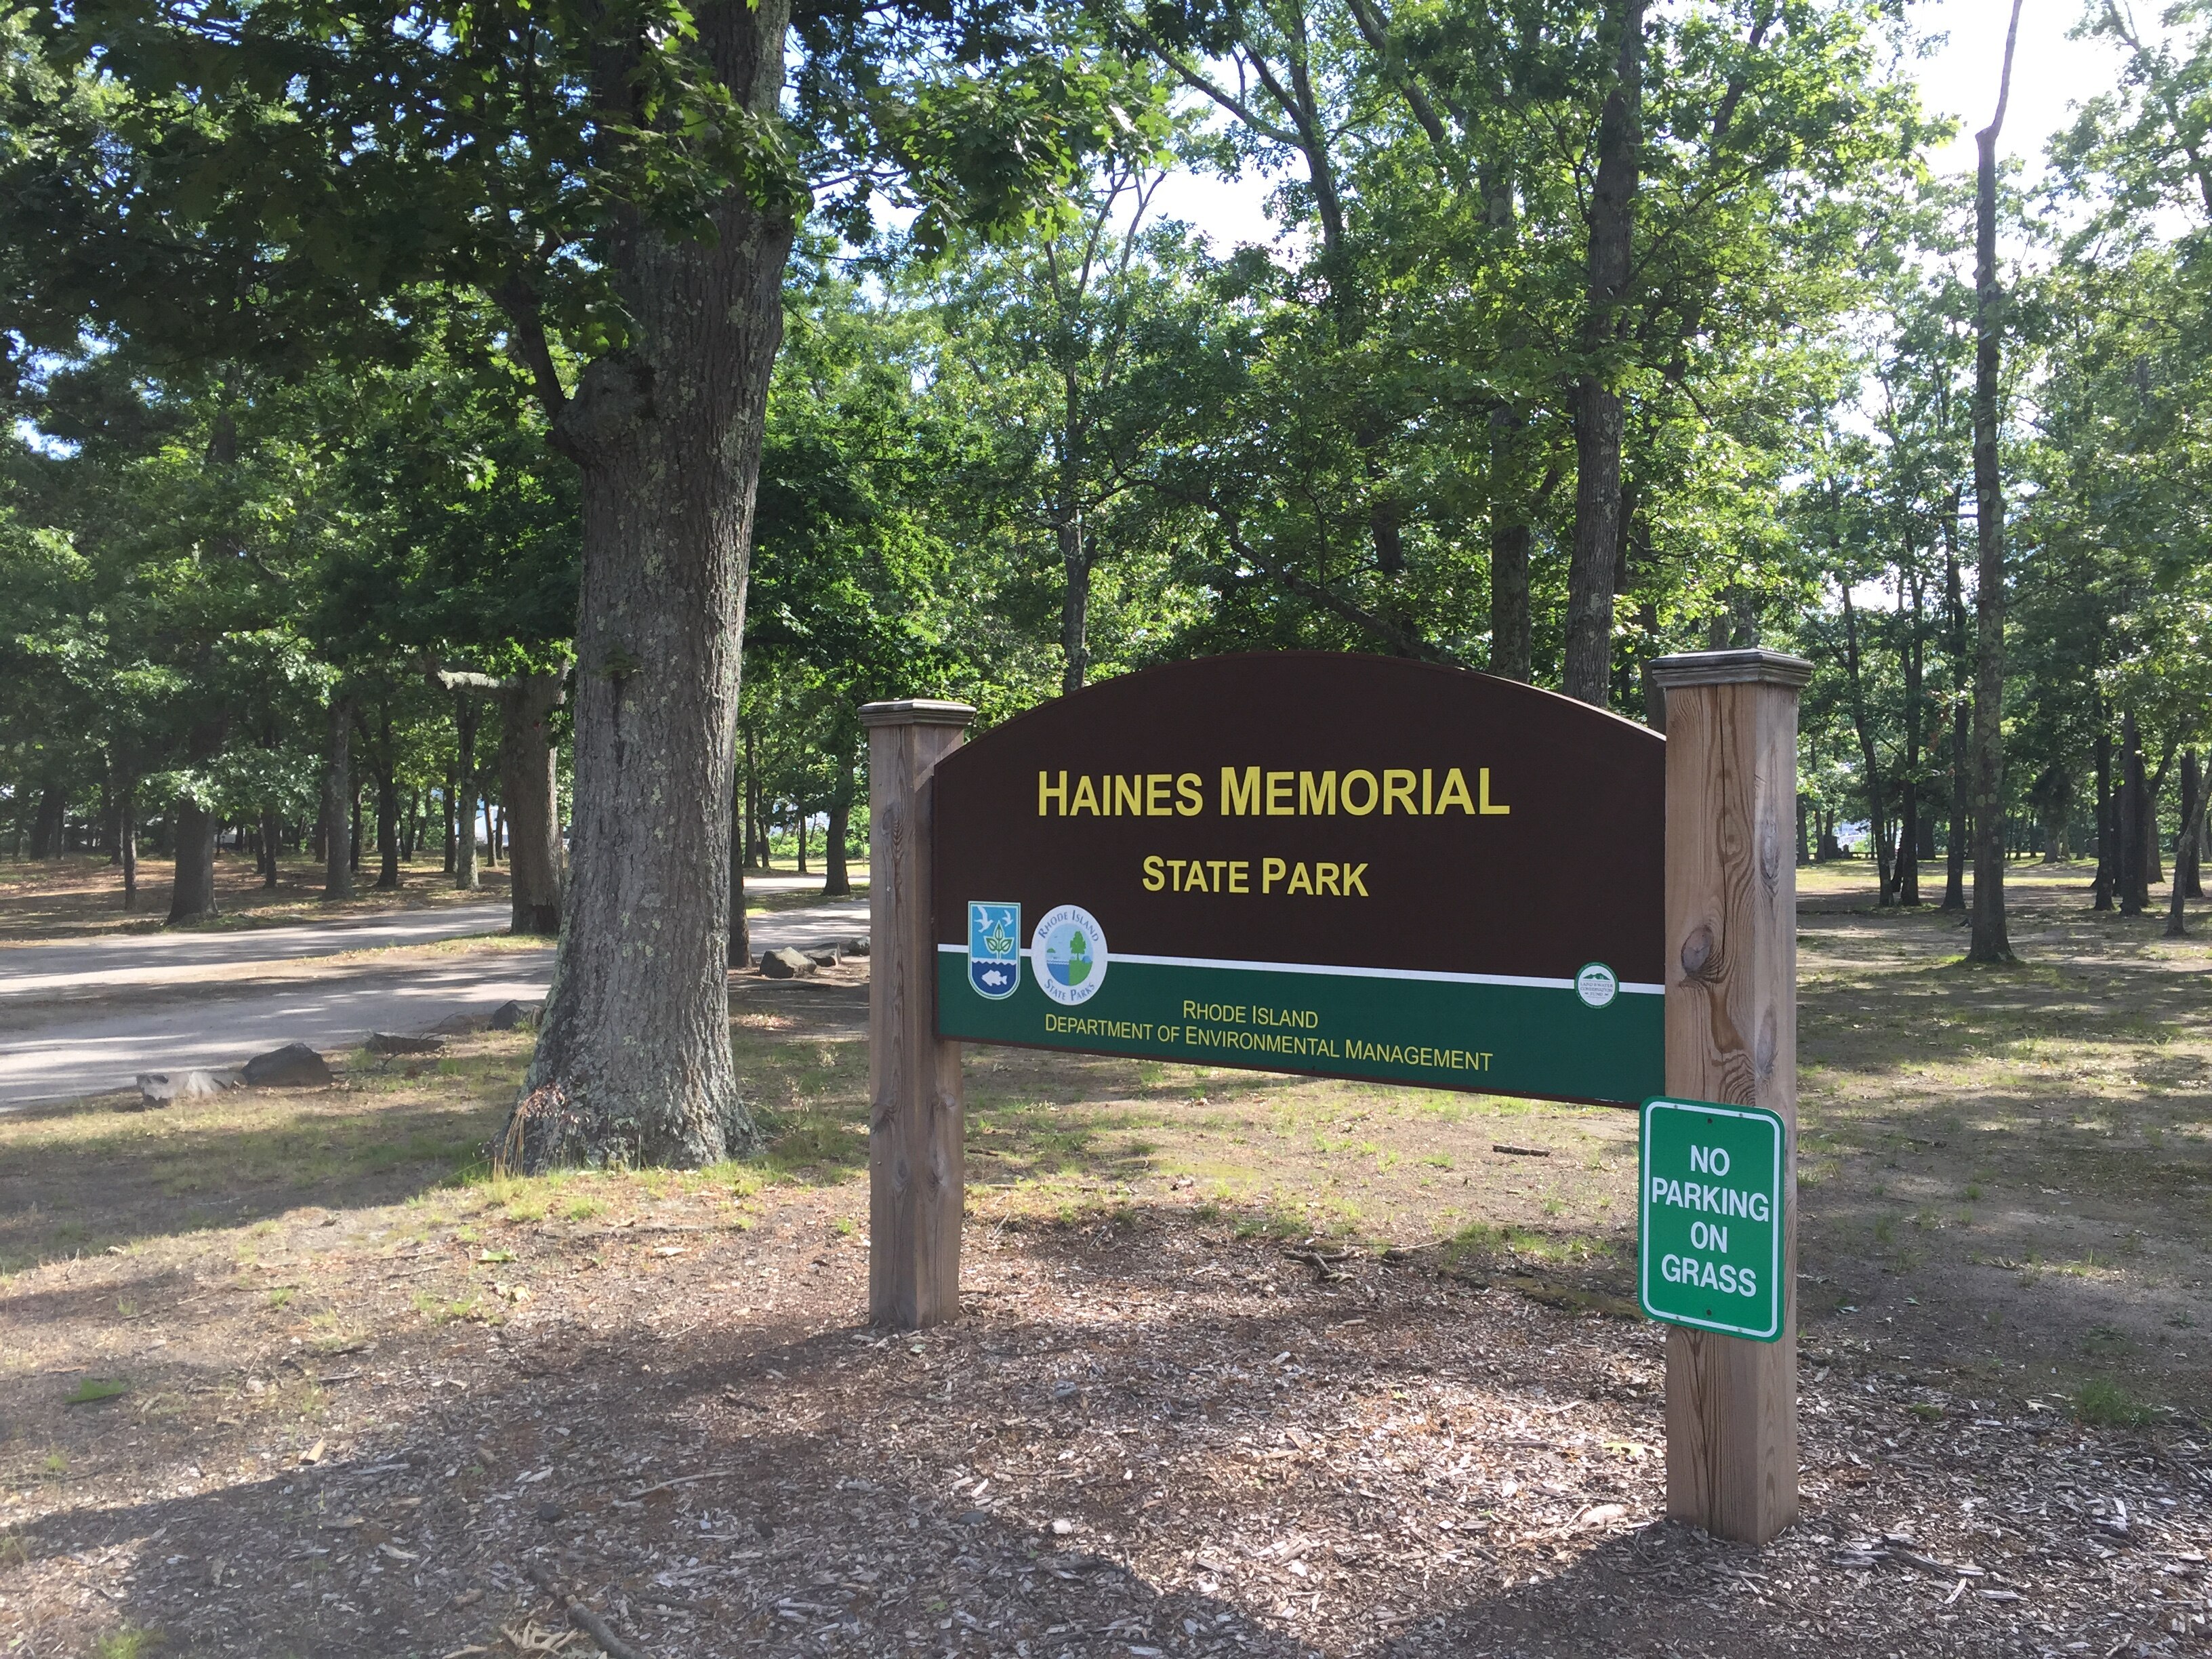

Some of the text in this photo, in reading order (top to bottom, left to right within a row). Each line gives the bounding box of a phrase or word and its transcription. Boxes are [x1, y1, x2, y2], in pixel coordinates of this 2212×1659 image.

[1038, 766, 1510, 817] HAINES MEMORIAL
[1142, 855, 1369, 897] STATE PARK
[1038, 909, 1099, 942] RHODE ISLAND
[1044, 979, 1095, 1001] STATE PARKS
[1183, 1000, 1318, 1029] RHODE ISLAND
[1046, 1013, 1493, 1071] DEPARTMENT OF ENVIRONMENTAL MANAGEMENT
[1690, 1145, 1730, 1176] NO
[1652, 1176, 1769, 1222] PARKING
[1690, 1221, 1727, 1253] ON
[1662, 1254, 1756, 1297] GRASS
